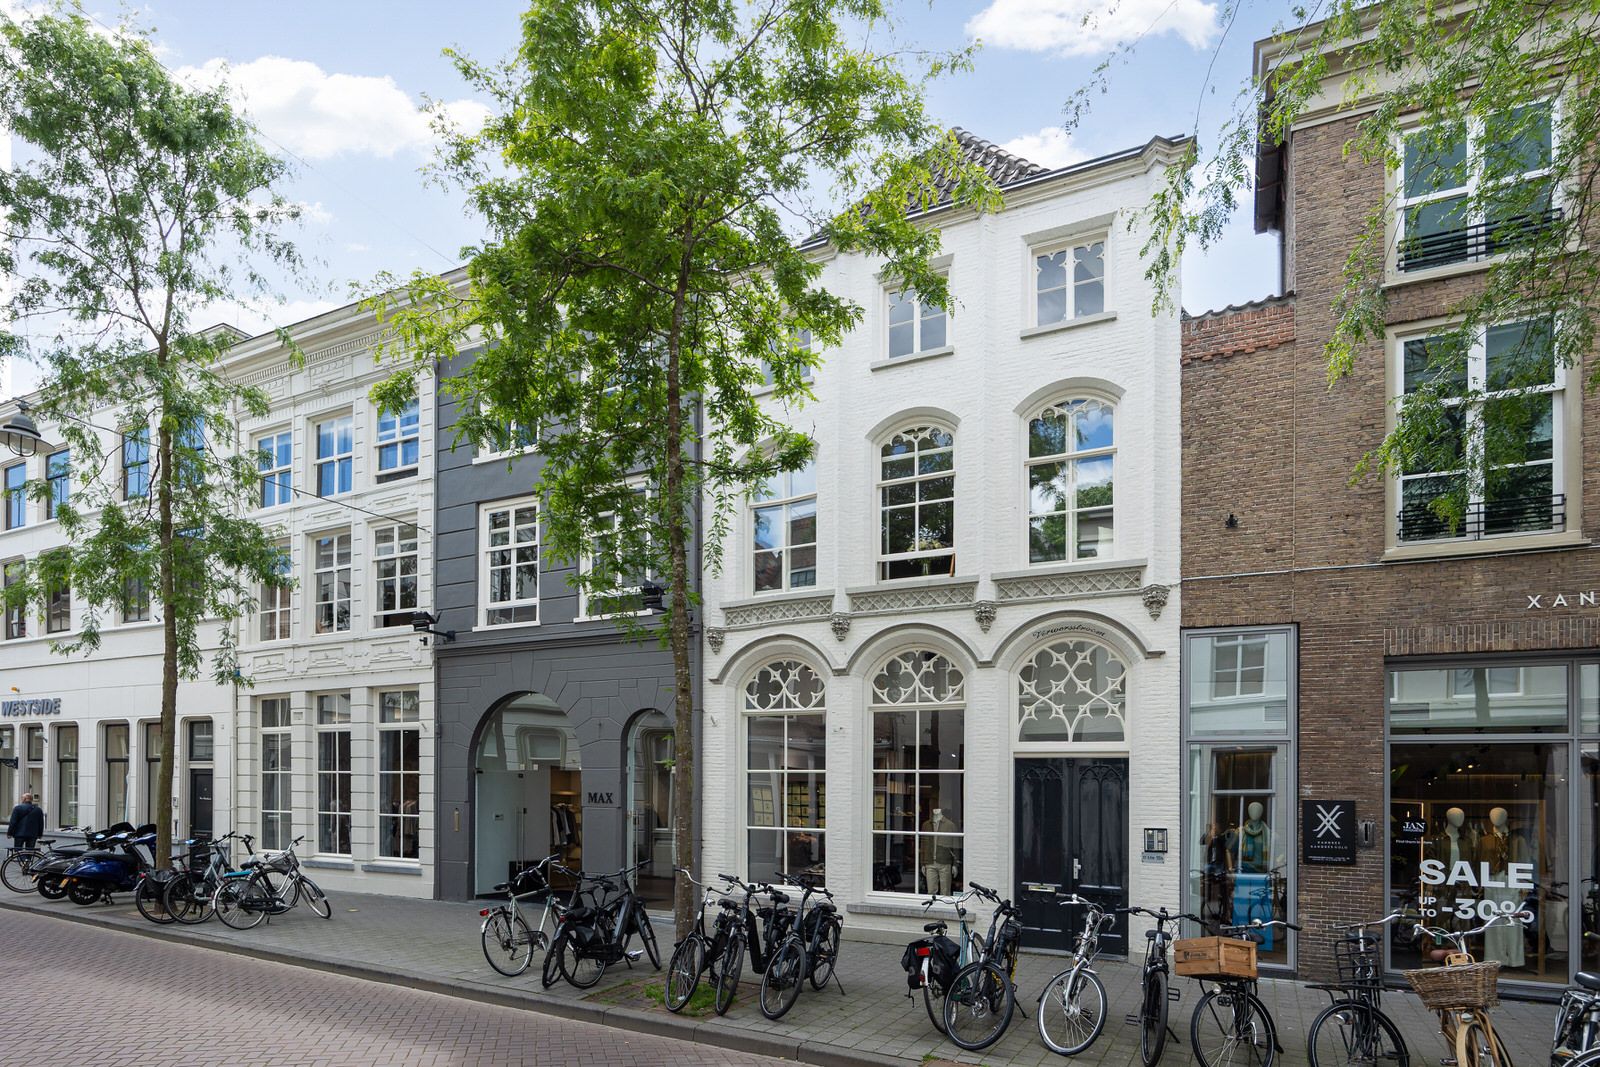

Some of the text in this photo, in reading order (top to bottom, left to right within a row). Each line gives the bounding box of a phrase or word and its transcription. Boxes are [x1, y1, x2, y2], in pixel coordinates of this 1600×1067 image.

[1, 697, 61, 717] WESTSIDE
[588, 792, 613, 804] MAX
[1418, 859, 1534, 889] SALE
[1418, 896, 1437, 905] UP
[1418, 908, 1437, 917] TO
[1441, 898, 1535, 923] -30%
